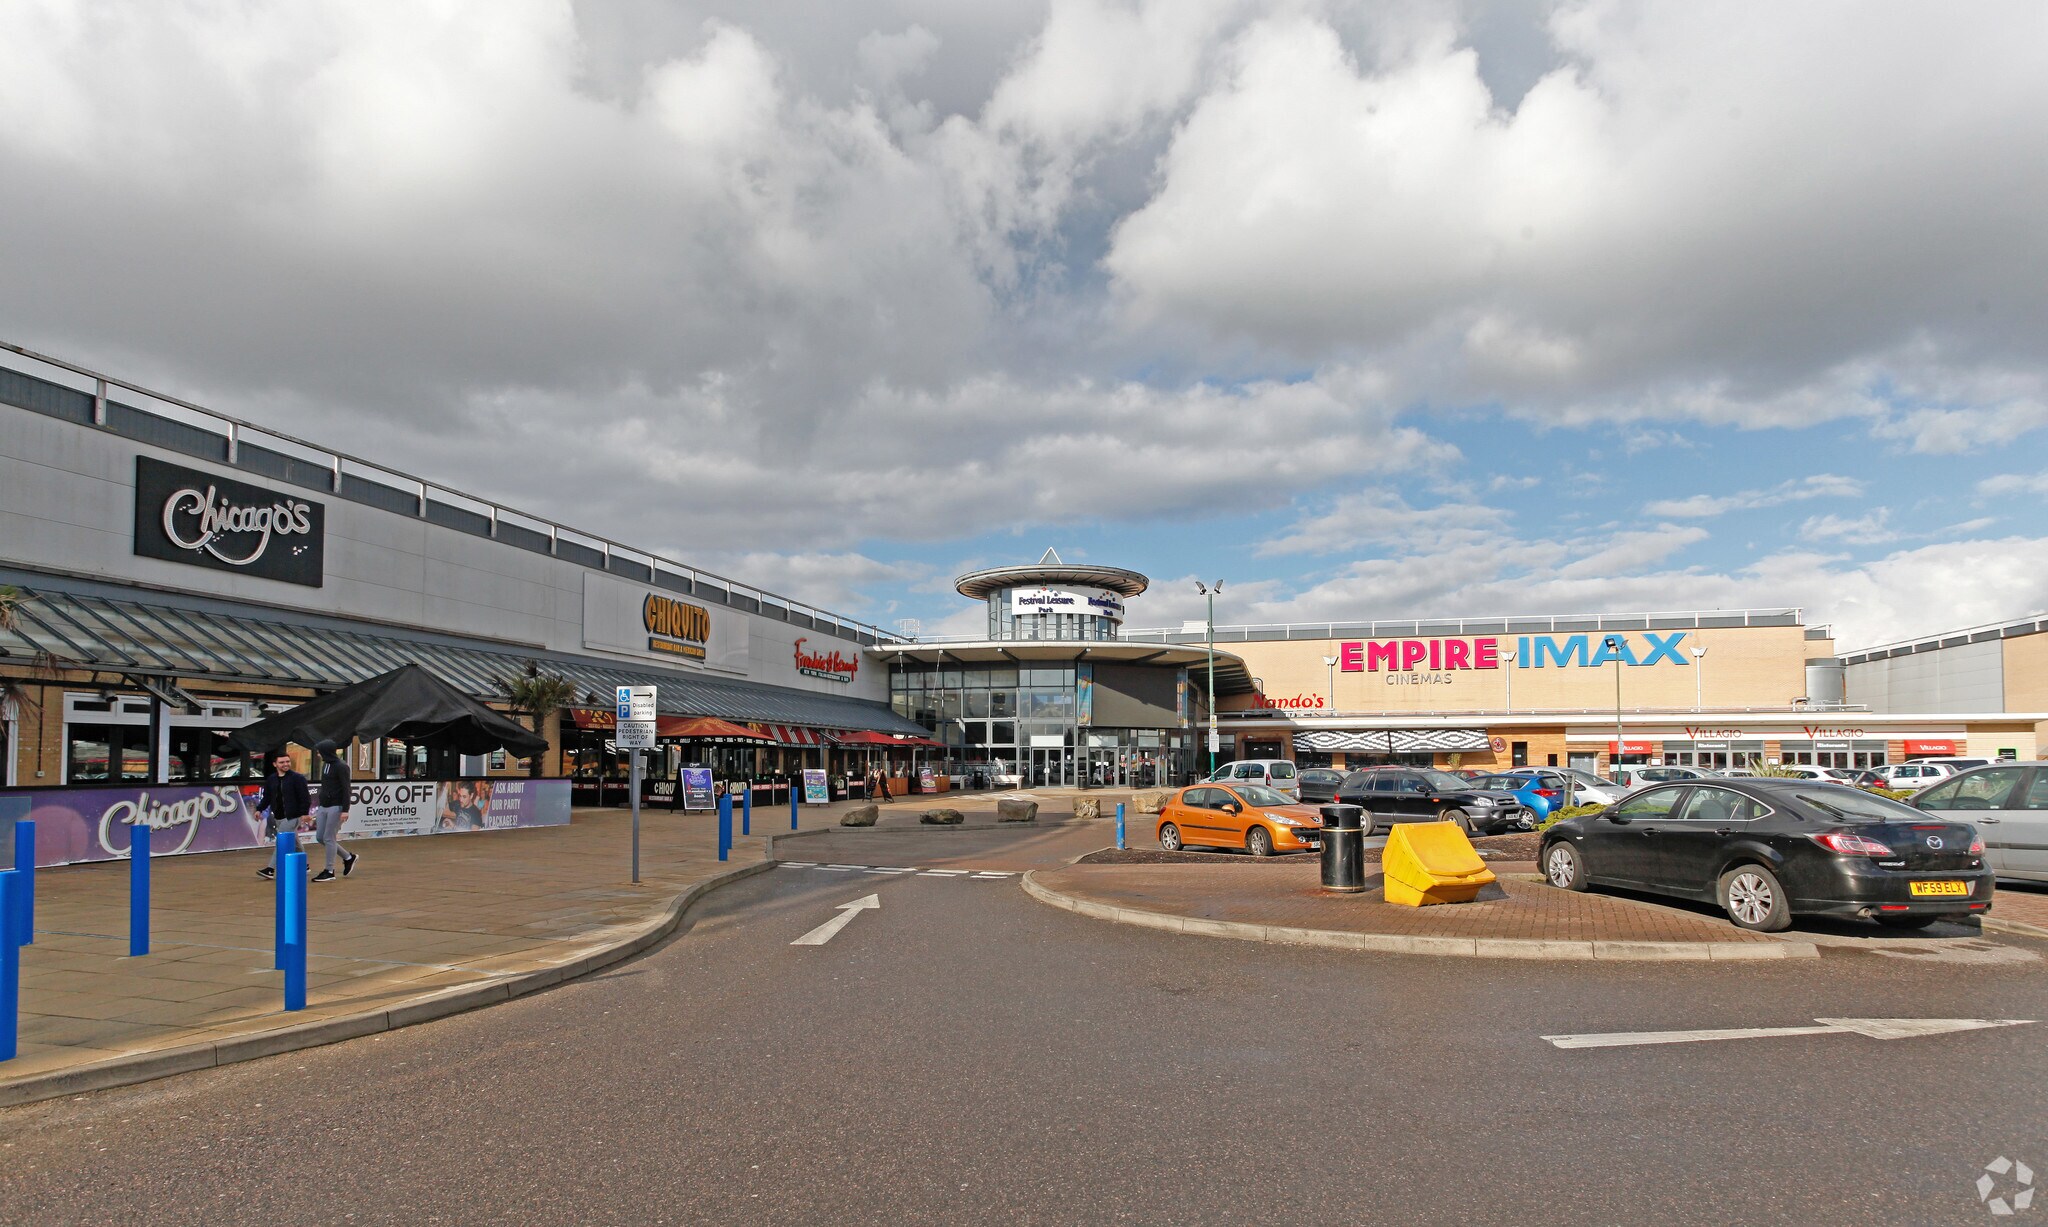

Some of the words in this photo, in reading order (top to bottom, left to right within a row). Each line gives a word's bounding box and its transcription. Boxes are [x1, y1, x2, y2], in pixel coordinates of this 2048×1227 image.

[162, 485, 311, 565] Chicago's
[1019, 596, 1045, 605] Festival
[1046, 596, 1075, 605] Leisure
[643, 592, 710, 645] CHIQUITO
[1340, 638, 1499, 672] EMPIRE
[1517, 632, 1690, 668] IMAX
[1386, 673, 1453, 685] CINEMAS
[1250, 693, 1324, 709] Nando's
[495, 783, 507, 793] ASK
[507, 782, 525, 793] ABOUT
[654, 782, 676, 795] CHIQU
[350, 785, 390, 805] 50%
[395, 785, 433, 803] OFF
[492, 799, 503, 810] OUR
[503, 799, 521, 810] PARTY
[366, 805, 417, 818] Everything
[99, 785, 238, 857] Chicago's
[488, 815, 518, 827] PACKAGES!
[1944, 882, 1963, 893] ELX
